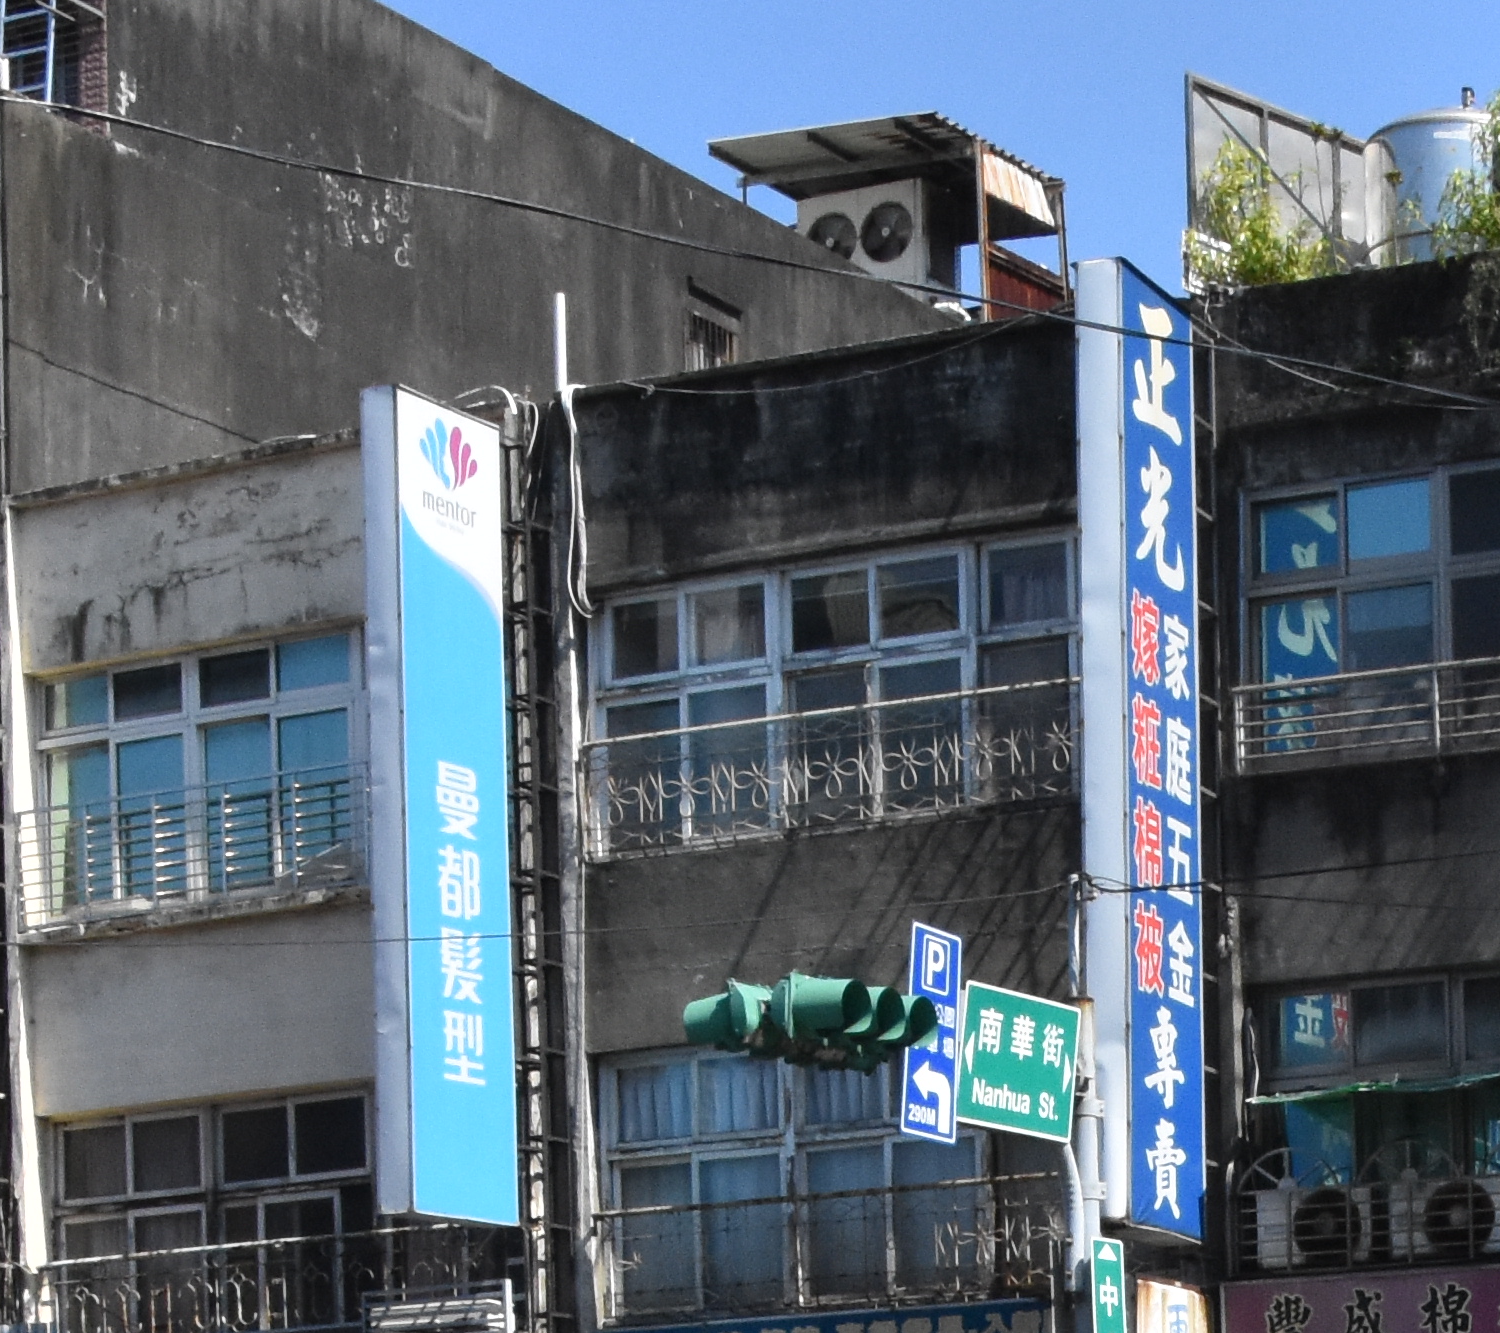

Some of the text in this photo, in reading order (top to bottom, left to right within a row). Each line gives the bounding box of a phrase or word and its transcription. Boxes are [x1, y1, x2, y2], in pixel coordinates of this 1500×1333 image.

[422, 488, 478, 530] mentor
[1131, 302, 1185, 594] 正光
[1164, 614, 1196, 1008] 家庭五金
[436, 760, 487, 1087] 曼都髮型
[972, 1077, 1059, 1120] Nanhua St.
[978, 1007, 1064, 1068] 南華街
[908, 1103, 936, 1126] 290M
[1143, 1008, 1187, 1220] 專賣
